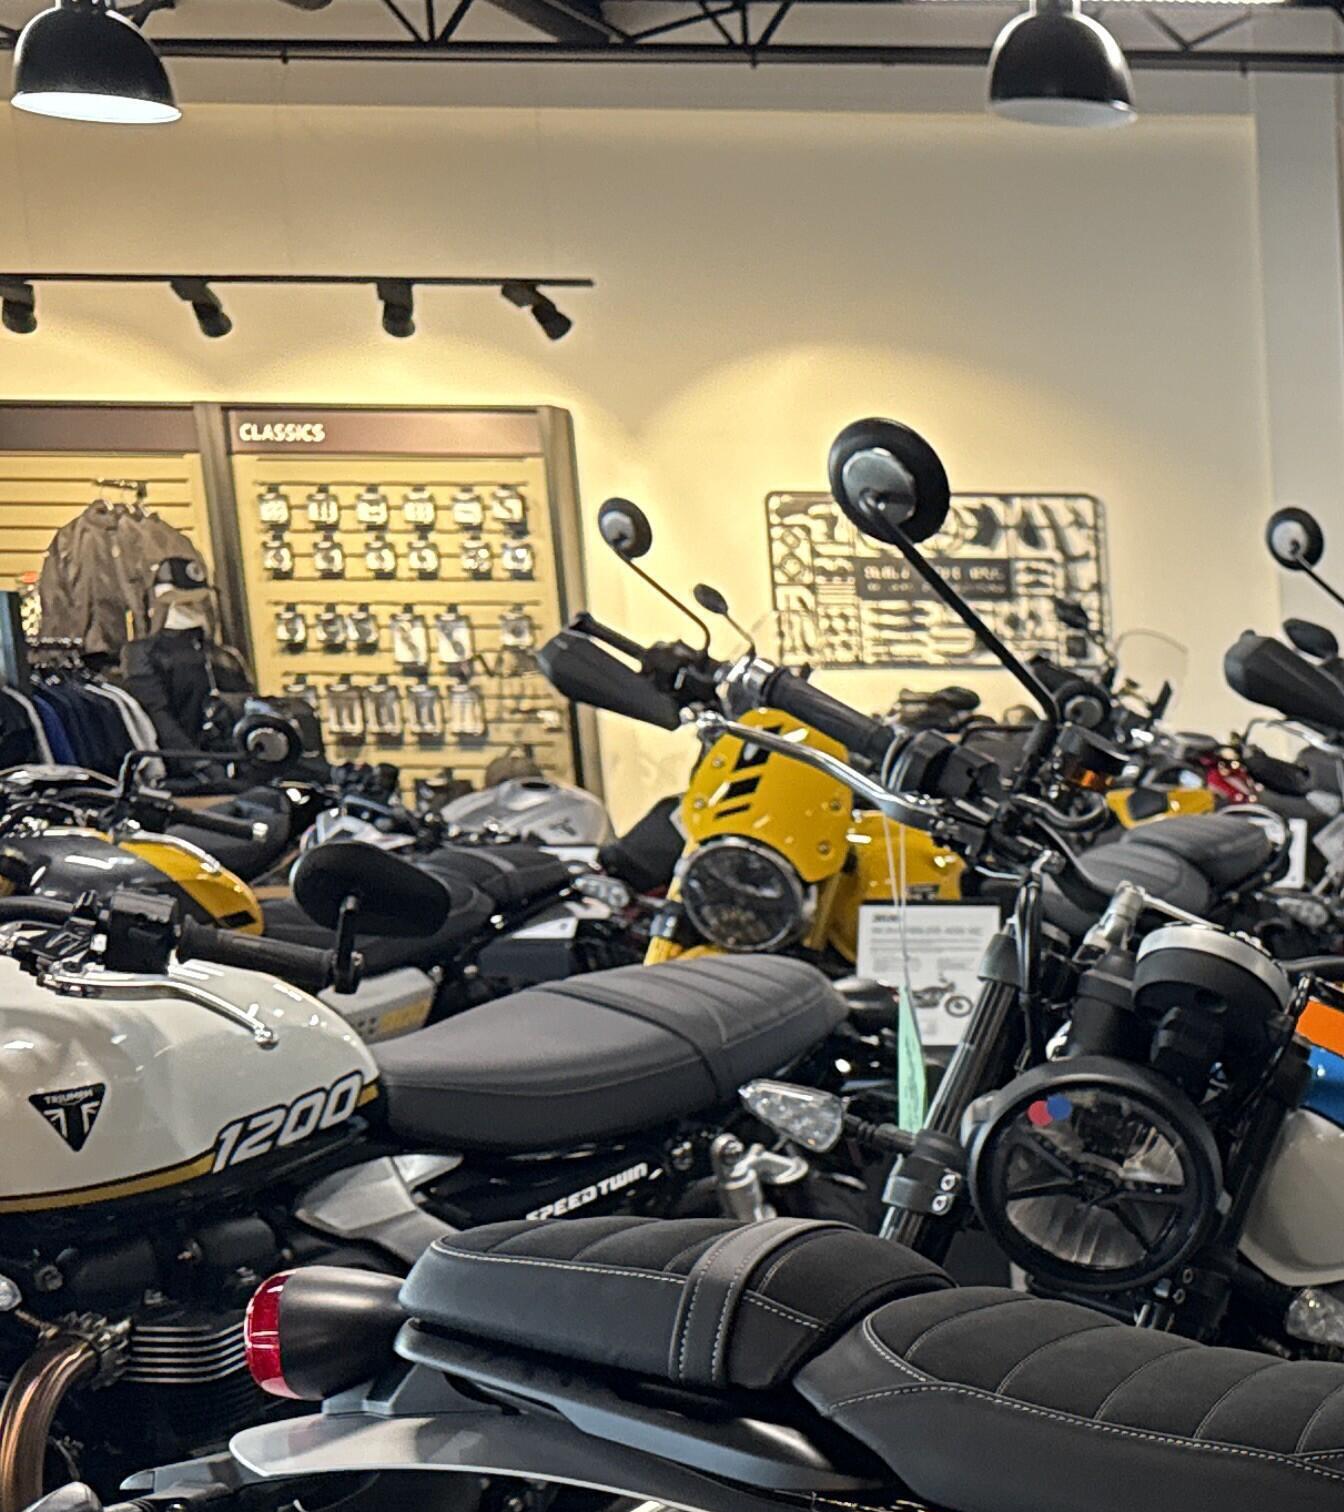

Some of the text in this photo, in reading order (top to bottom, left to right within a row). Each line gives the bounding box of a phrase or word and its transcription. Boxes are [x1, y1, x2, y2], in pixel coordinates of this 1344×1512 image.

[239, 423, 325, 442] CLASSICS
[212, 1071, 363, 1174] 1200
[526, 1162, 648, 1220] SPEED TWIN
